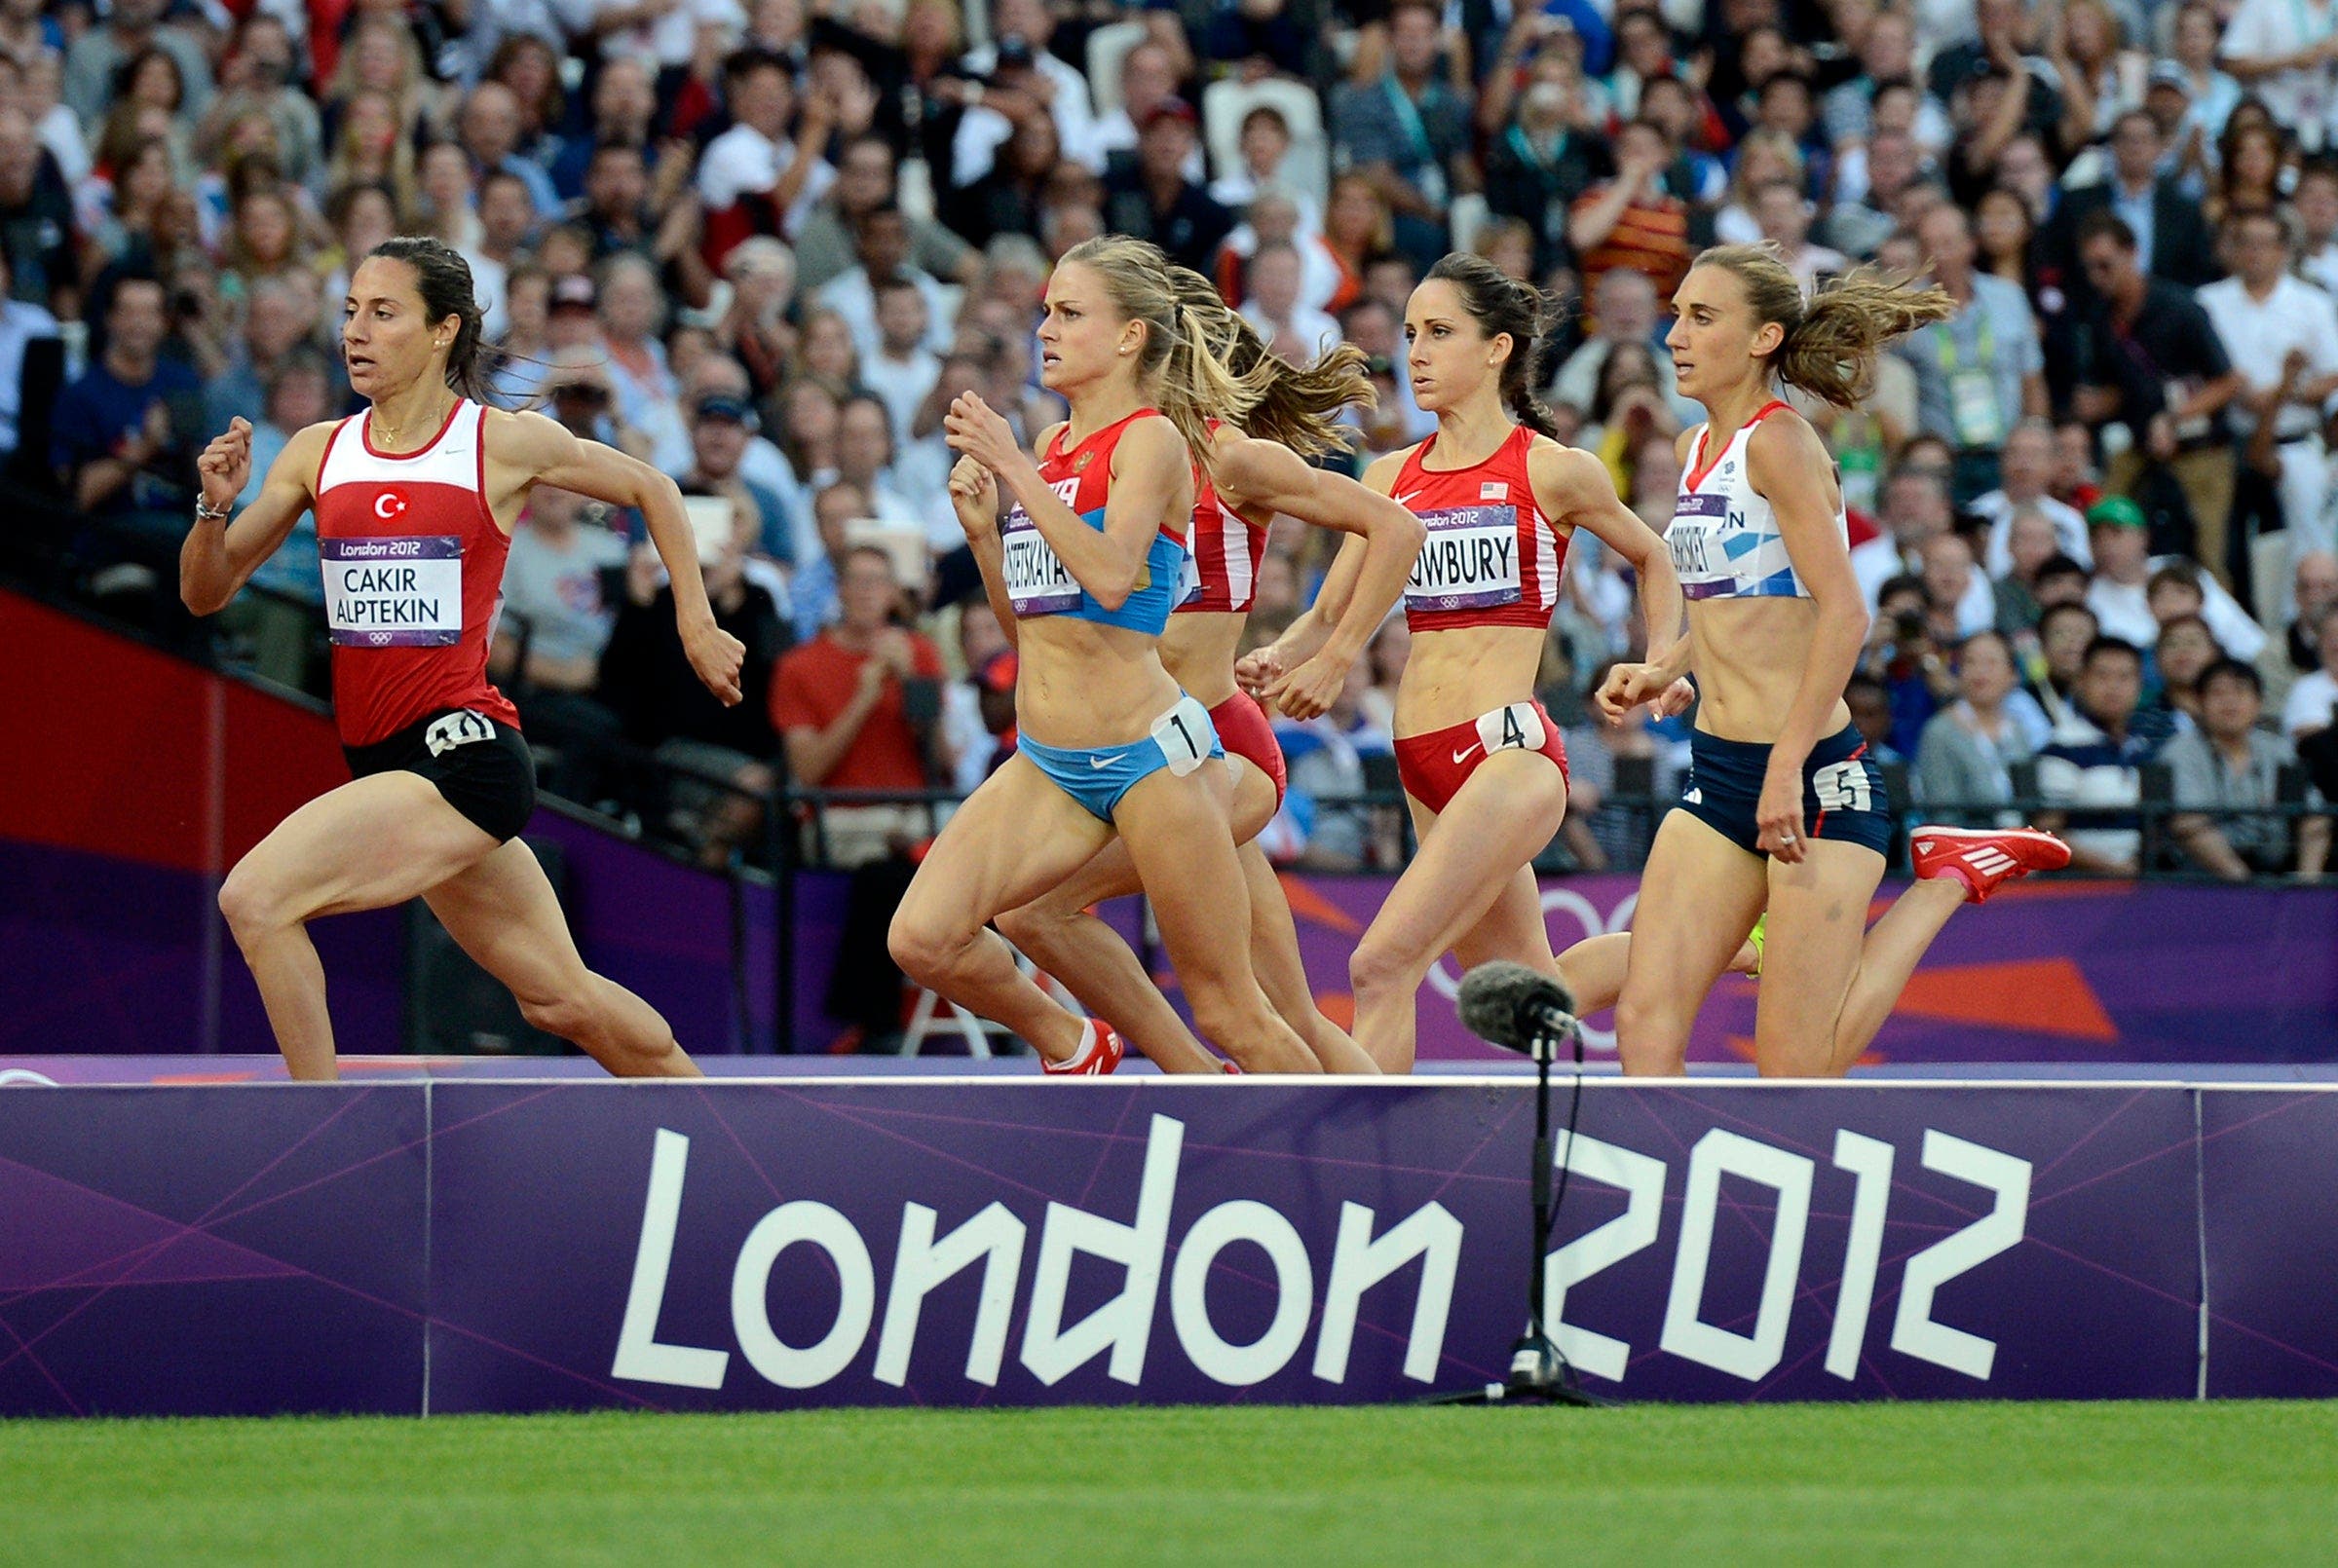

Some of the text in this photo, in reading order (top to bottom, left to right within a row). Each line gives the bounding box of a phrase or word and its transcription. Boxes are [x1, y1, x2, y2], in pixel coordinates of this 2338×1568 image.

[1451, 511, 1480, 525] 2012
[340, 541, 421, 556] London 2012
[344, 568, 417, 592] CAKIR
[336, 598, 439, 623] ALPTEKIN
[1170, 714, 1198, 760] 1
[1502, 706, 1525, 748] 4
[1837, 768, 1857, 809] 5
[611, 1113, 2033, 1390] London 2012
